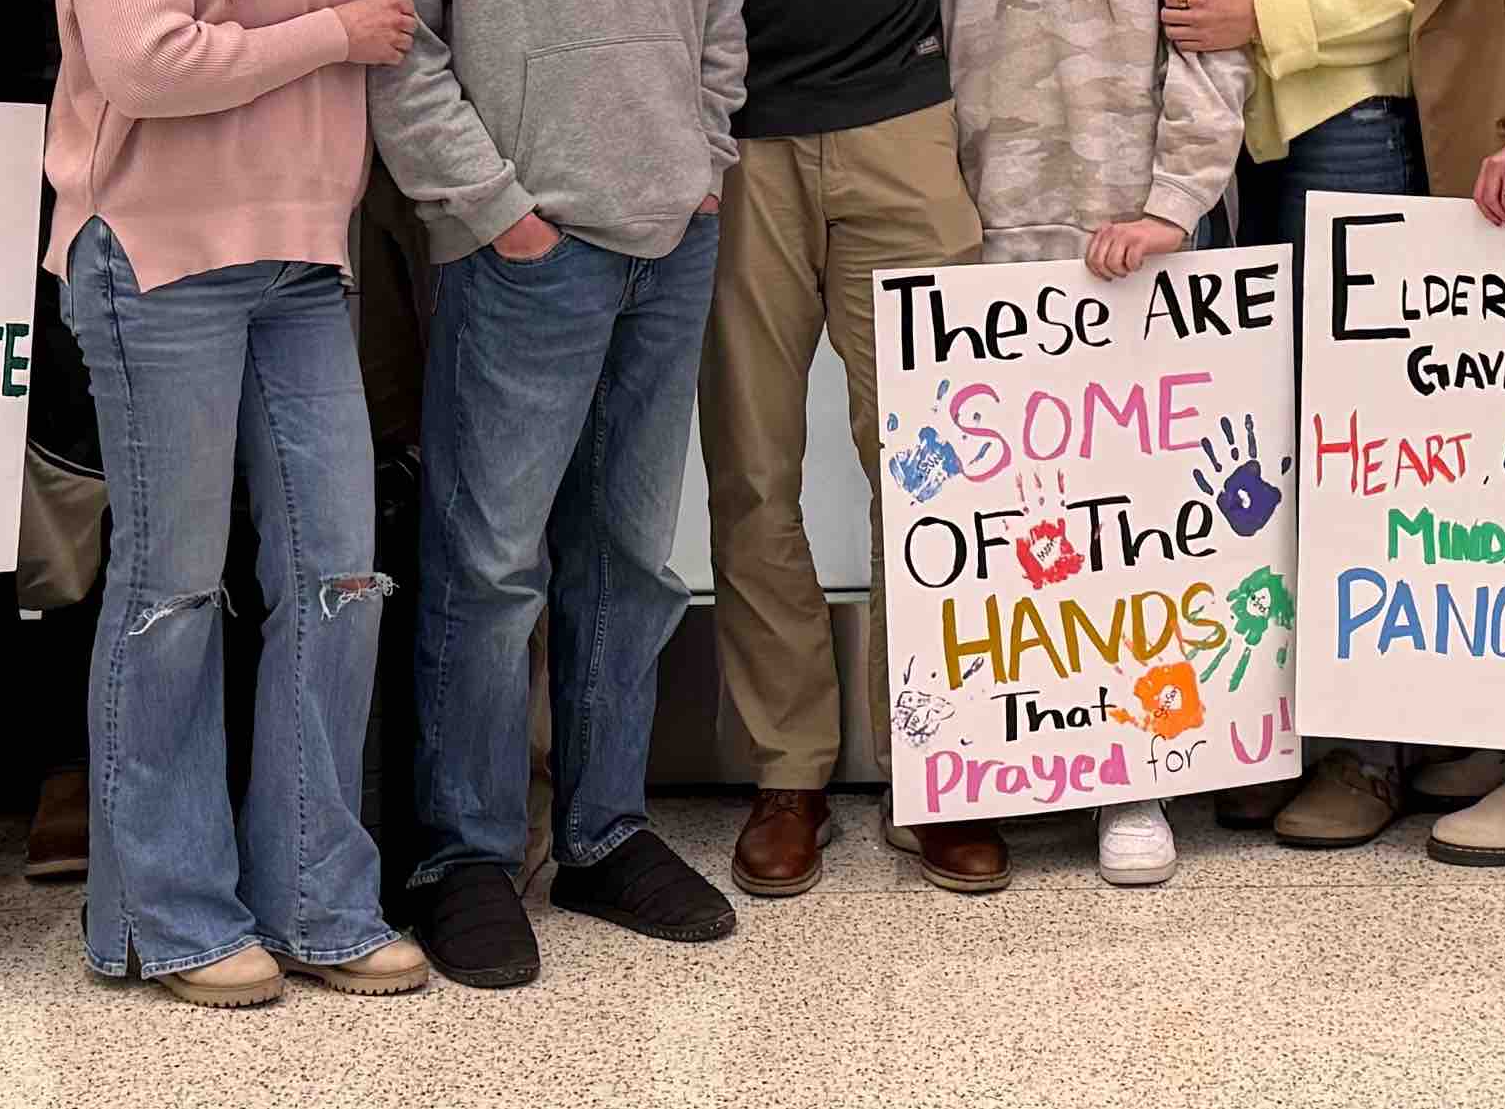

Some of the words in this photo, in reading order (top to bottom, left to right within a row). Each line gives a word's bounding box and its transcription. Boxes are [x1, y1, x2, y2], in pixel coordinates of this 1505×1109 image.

[882, 274, 1112, 371] These
[1144, 263, 1280, 341] ARE
[949, 372, 1212, 483] SOME
[904, 510, 1024, 588] OF
[1066, 495, 1216, 573] The
[942, 582, 1227, 690] HANDS
[990, 686, 1116, 742] That
[1146, 734, 1207, 783] for
